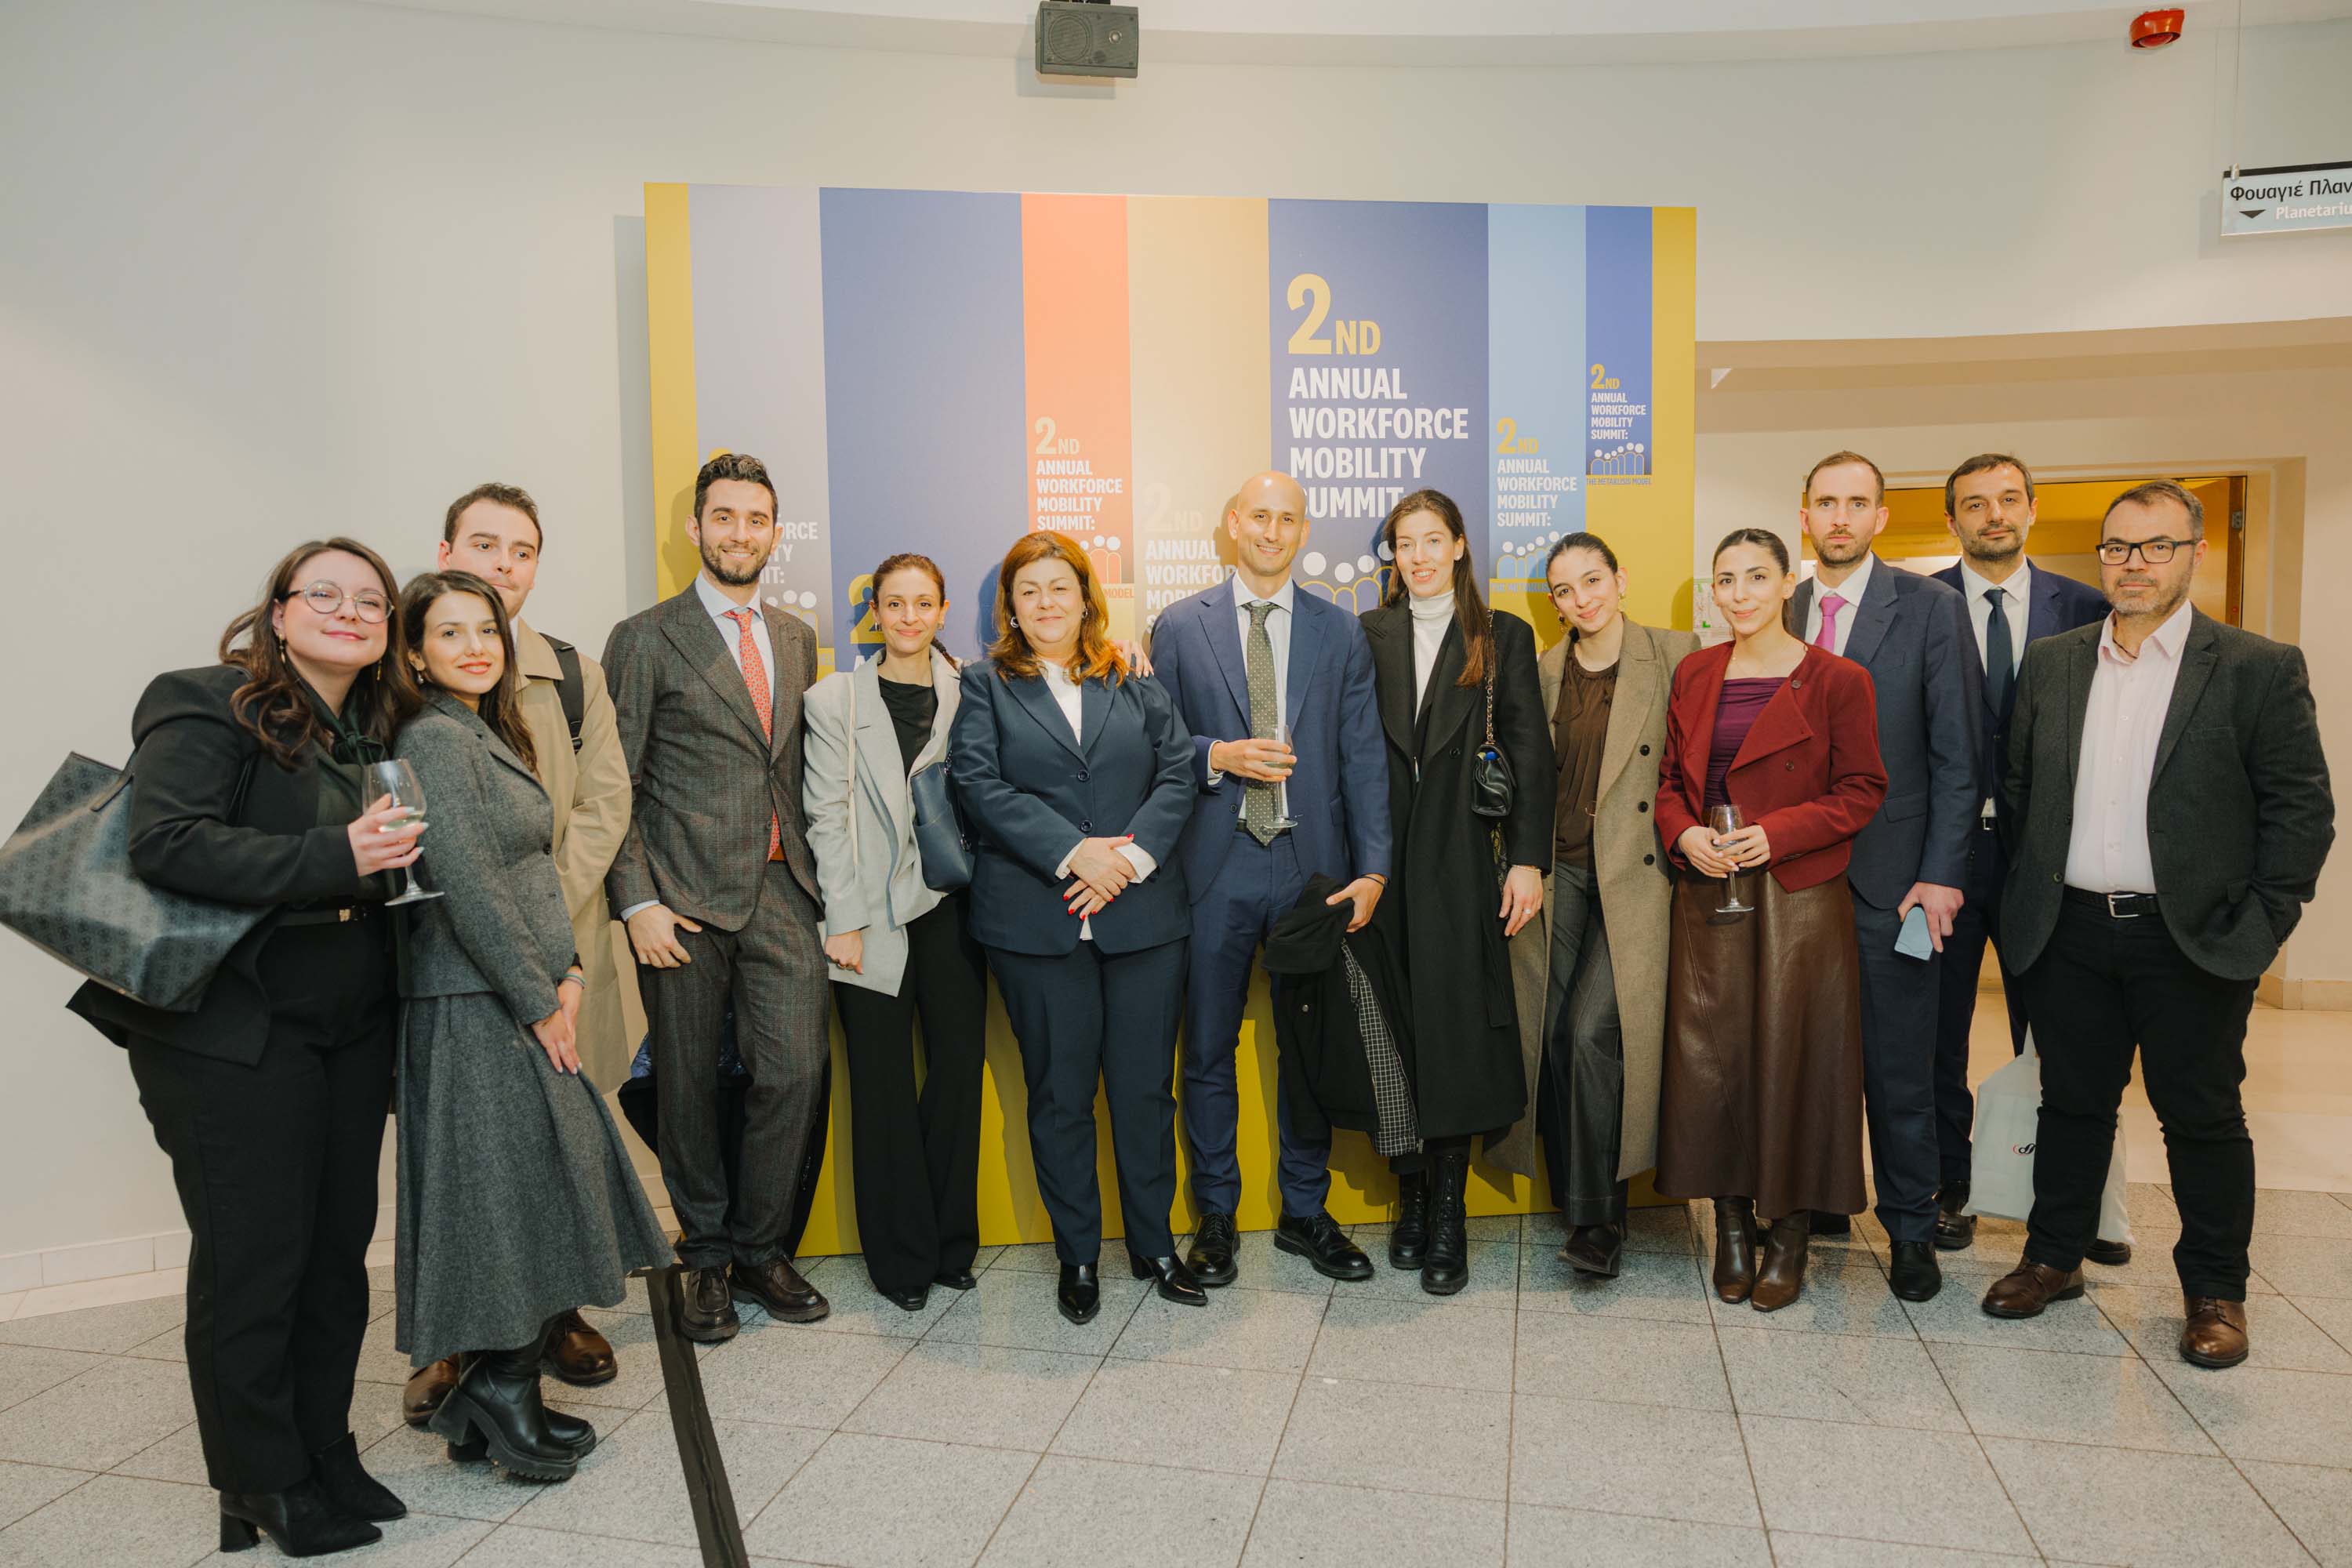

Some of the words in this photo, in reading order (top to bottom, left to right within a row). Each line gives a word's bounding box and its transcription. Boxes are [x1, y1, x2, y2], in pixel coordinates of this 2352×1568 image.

[2230, 180, 2303, 202] Φουαγιέ
[1287, 273, 1381, 354] 2ND
[1288, 367, 1408, 400] ANNUAL
[1590, 363, 1621, 390] 2ND
[1591, 393, 1628, 403] ANNUAL
[1591, 405, 1646, 416] WORKFORCE
[1288, 407, 1469, 439] WORKFORCE
[1591, 417, 1634, 428] MOBILITY
[1035, 416, 1080, 455] 2ND
[1497, 416, 1539, 454] 2ND
[1591, 430, 1629, 440] SUMMIT:
[1036, 459, 1094, 475] ANNUAL
[1290, 447, 1428, 479] MOBILITY
[1497, 459, 1550, 474] ANNUAL
[1036, 478, 1123, 494] WORKFORCE
[1497, 477, 1577, 492] WORKFORCE
[1037, 496, 1103, 512] MOBILITY
[1302, 486, 1405, 518] UMMIT
[1497, 495, 1559, 510] MOBILITY
[1037, 515, 1096, 531] SUMMIT:
[1497, 512, 1552, 528] SUMMIT:
[1145, 539, 1221, 561] ANNUAL
